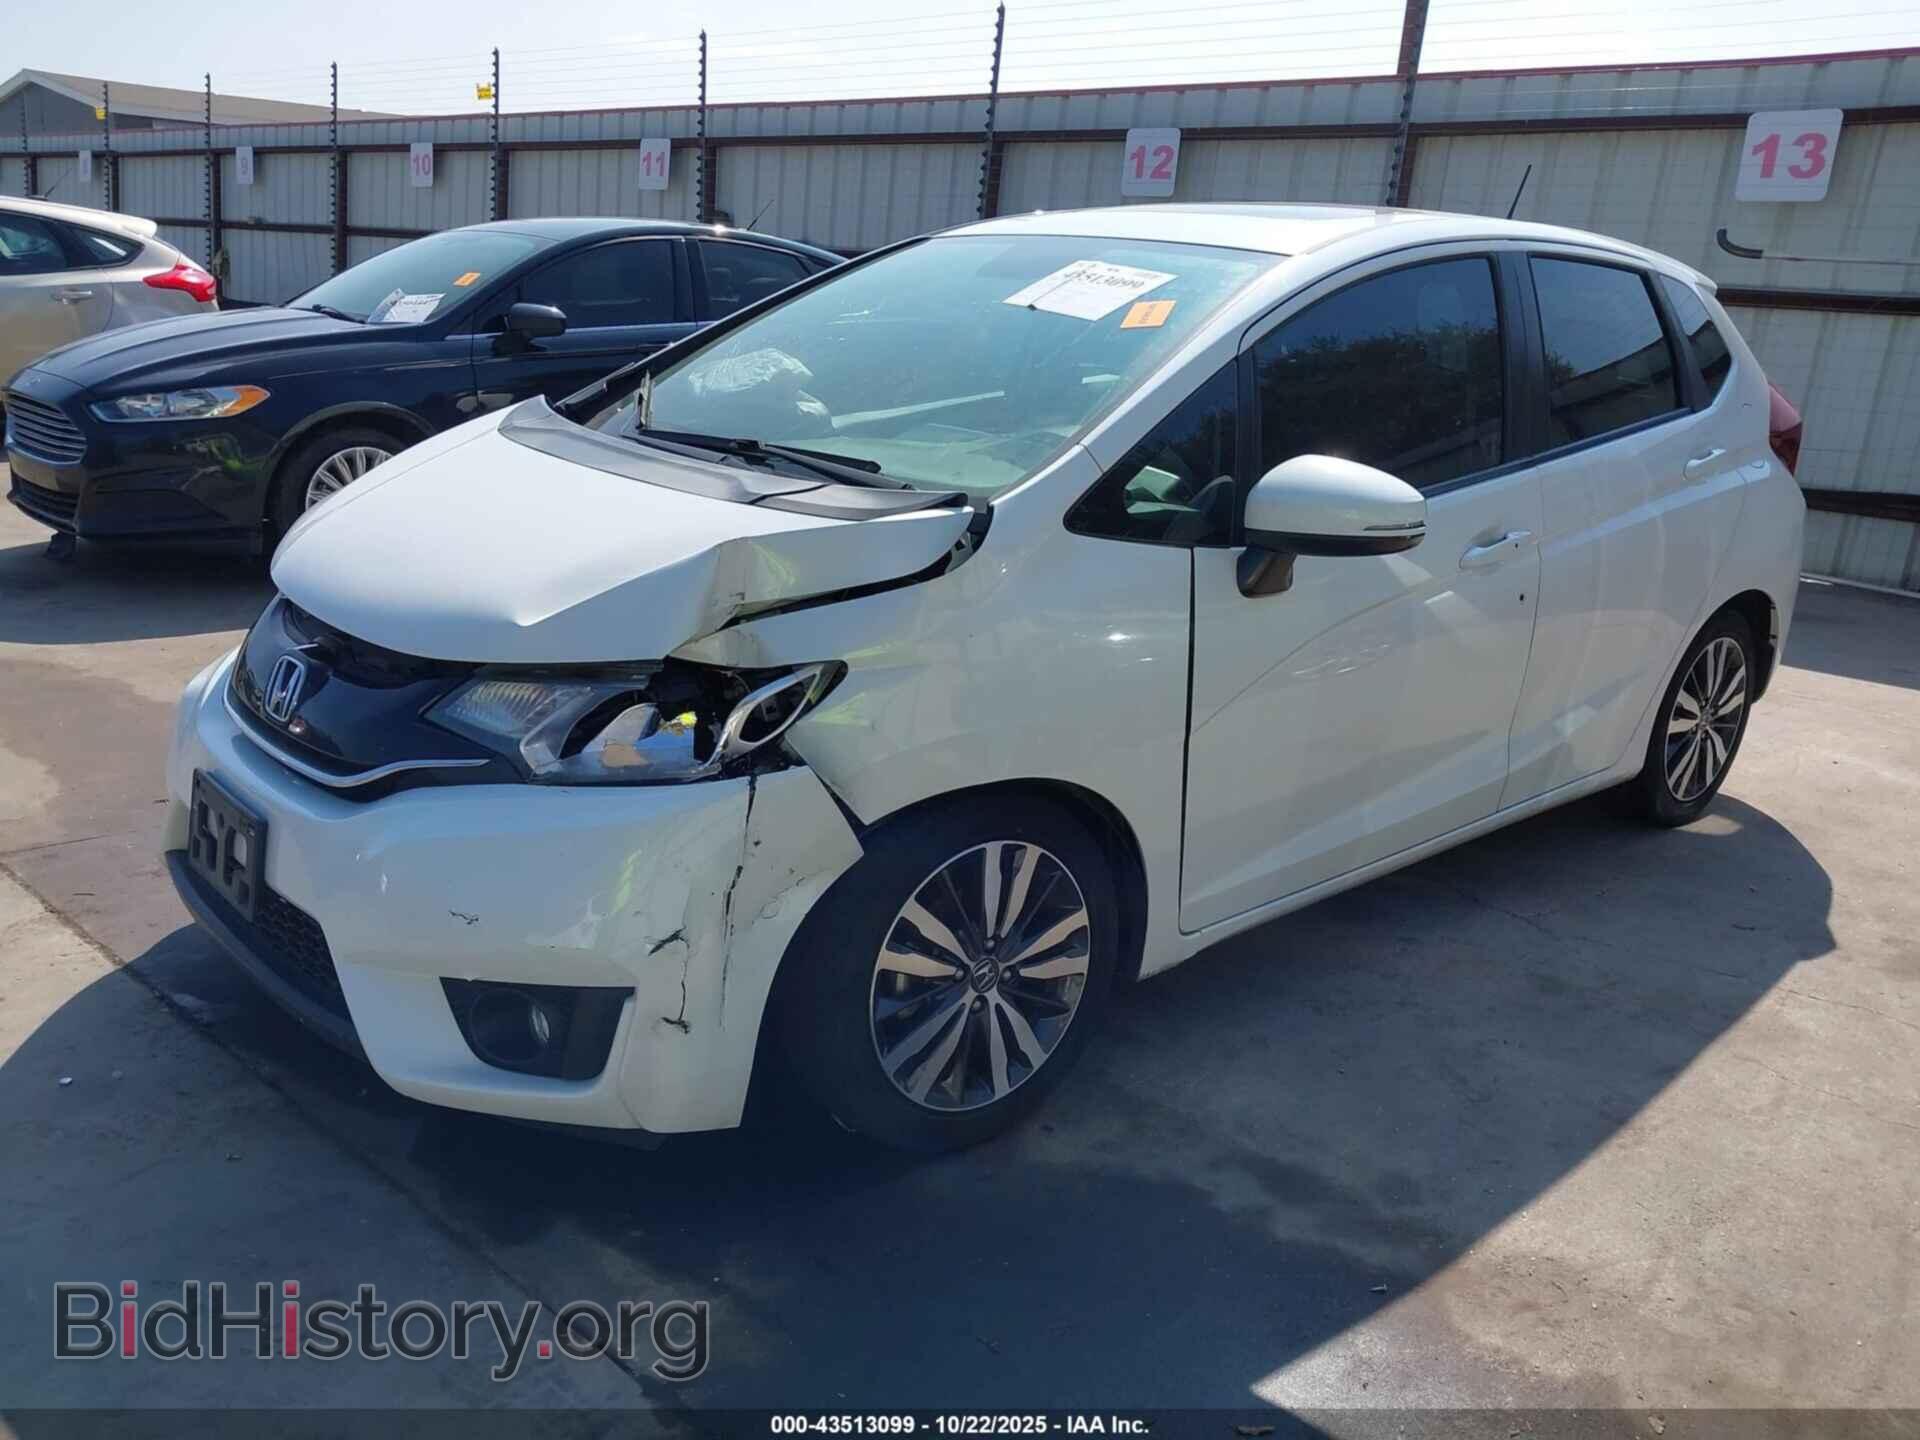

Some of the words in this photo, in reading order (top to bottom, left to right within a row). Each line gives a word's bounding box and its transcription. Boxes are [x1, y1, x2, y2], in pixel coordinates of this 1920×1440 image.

[412, 154, 432, 176] 10
[642, 152, 666, 177] 11
[1129, 144, 1175, 180] 12
[1752, 132, 1827, 178] 13
